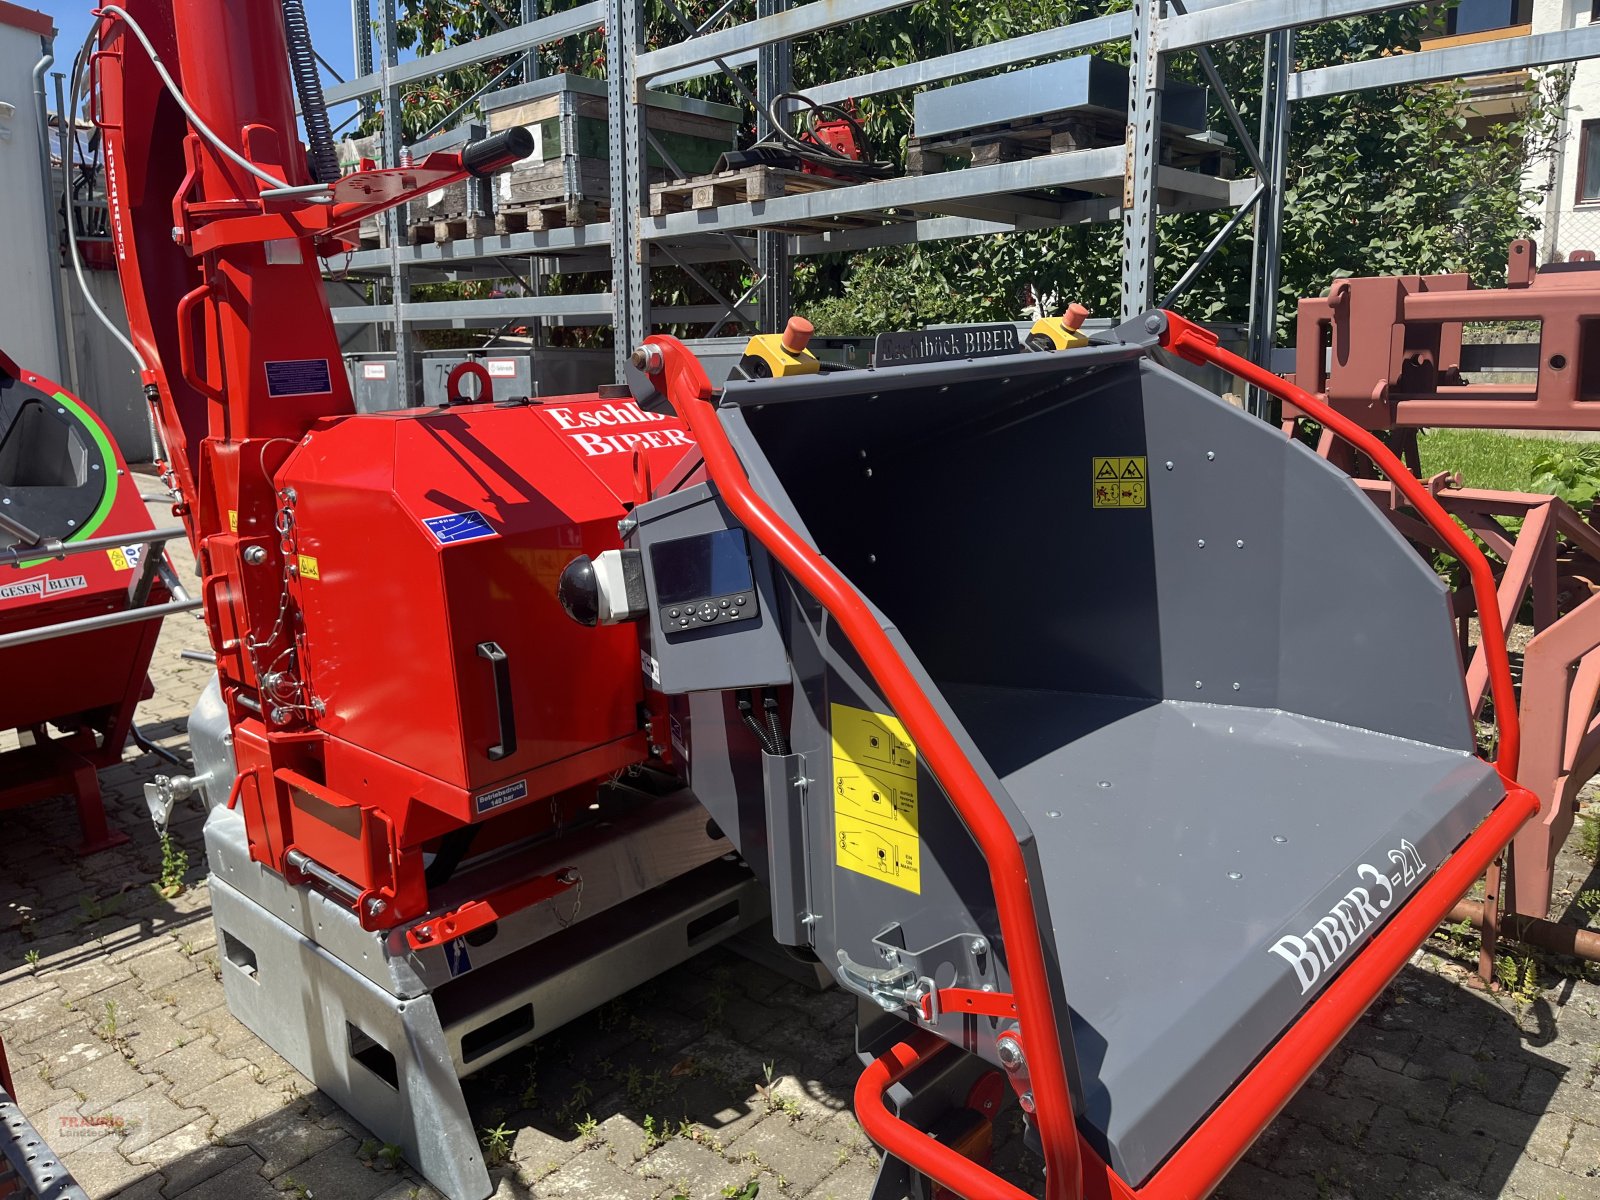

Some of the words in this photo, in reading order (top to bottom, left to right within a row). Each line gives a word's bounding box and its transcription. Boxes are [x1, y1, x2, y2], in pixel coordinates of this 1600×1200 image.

[964, 330, 1015, 354] BIBER
[544, 402, 678, 430] Eschlb
[568, 428, 697, 457] BIBER
[49, 577, 85, 590] BLITZ
[479, 783, 523, 803] Betriebsdruck
[491, 797, 502, 806] 140
[503, 794, 514, 802] bar
